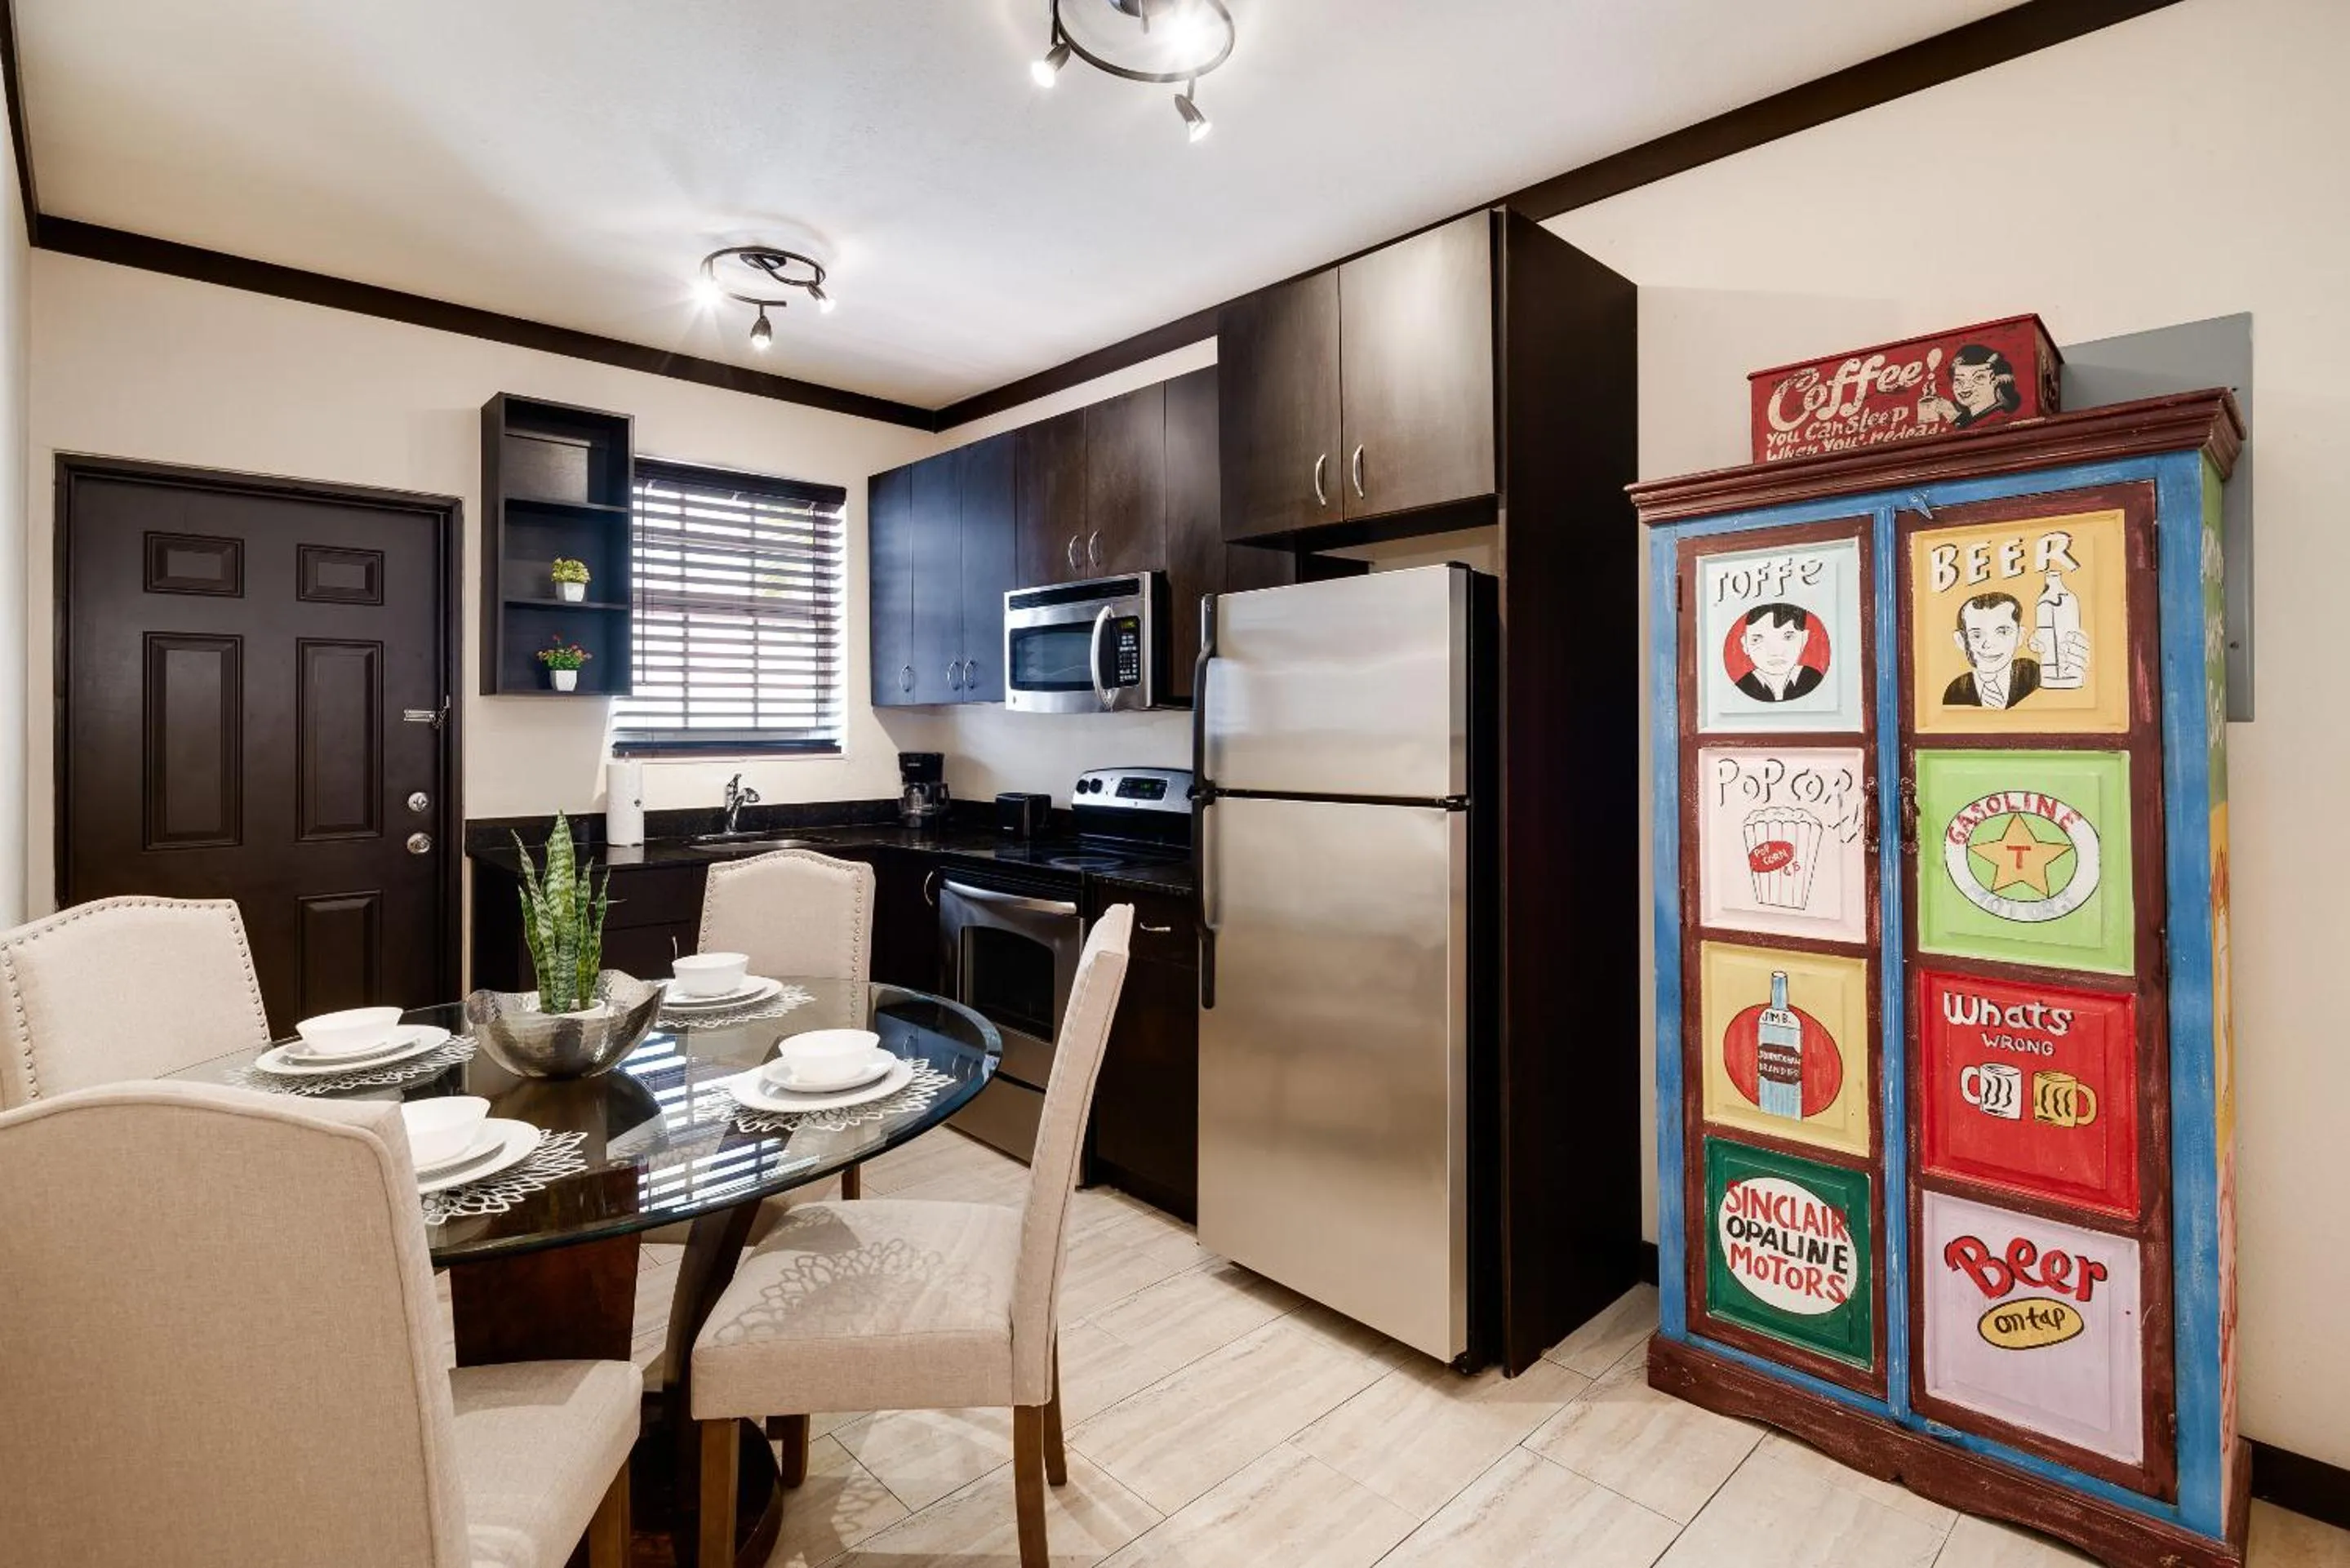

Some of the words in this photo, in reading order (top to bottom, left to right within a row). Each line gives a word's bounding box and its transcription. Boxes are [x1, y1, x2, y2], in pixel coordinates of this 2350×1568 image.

[1930, 531, 2081, 593] BEER
[1948, 790, 2082, 846] GASOLINE
[2006, 845, 2032, 870] T
[1981, 1032, 2056, 1057] WRONG
[1726, 1179, 1848, 1243] SINCLAIR
[1726, 1215, 1848, 1275] OPALINE
[1730, 1242, 1848, 1304] MOTORS
[1944, 1235, 2108, 1302] Beer
